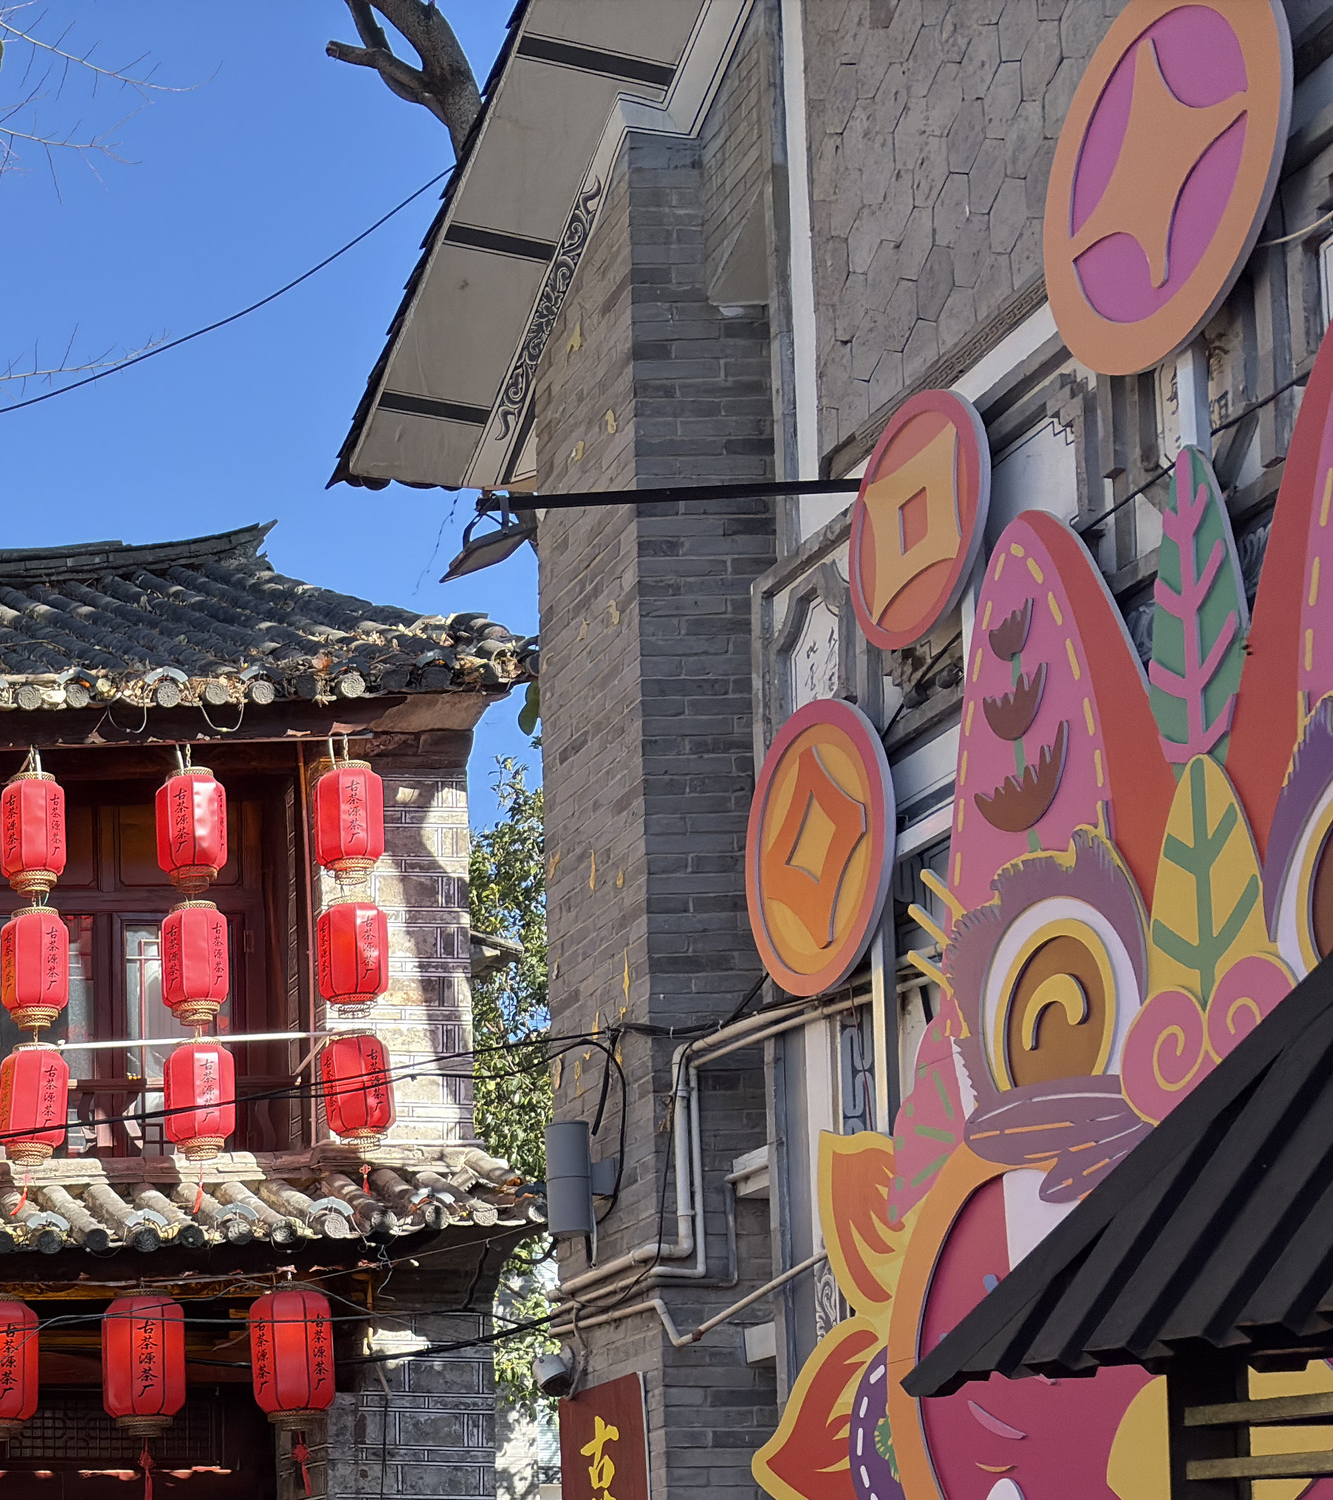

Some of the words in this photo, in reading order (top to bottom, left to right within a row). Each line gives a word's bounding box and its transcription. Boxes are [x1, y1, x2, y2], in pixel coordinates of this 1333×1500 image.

[136, 1320, 158, 1398] 古茶源茶厂
